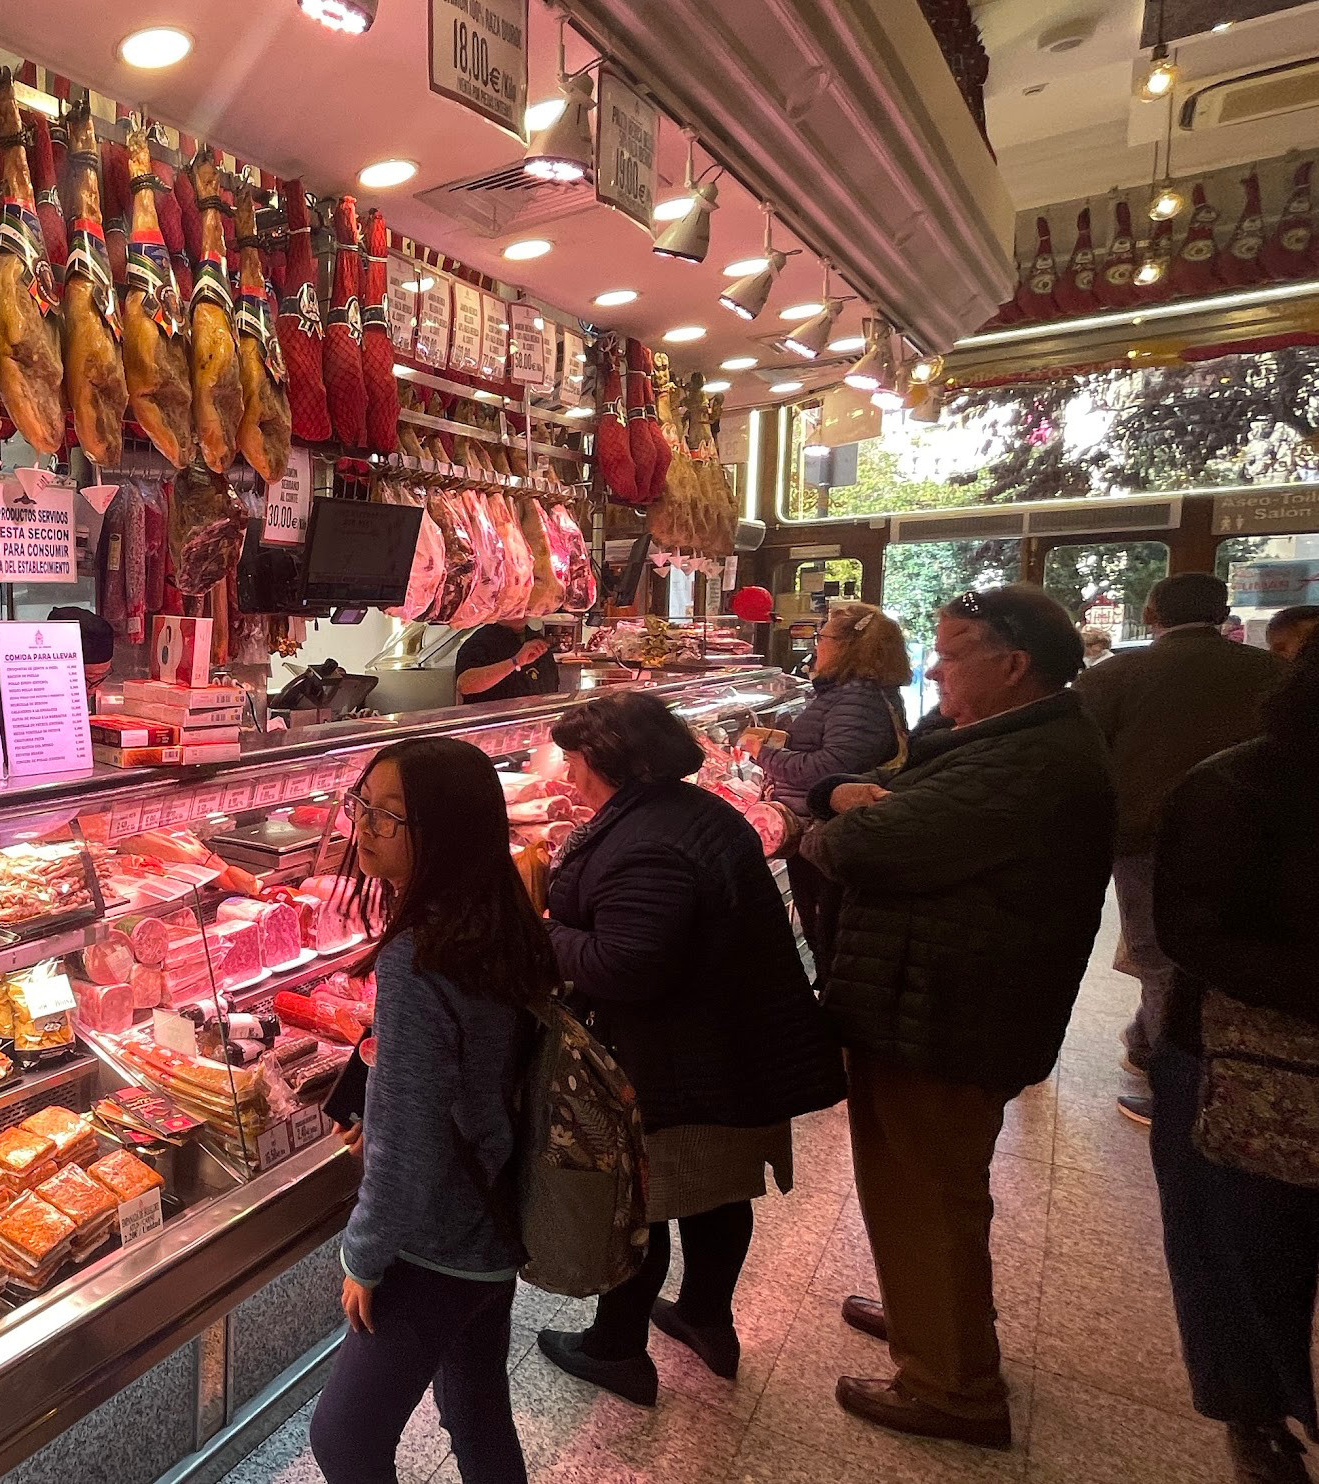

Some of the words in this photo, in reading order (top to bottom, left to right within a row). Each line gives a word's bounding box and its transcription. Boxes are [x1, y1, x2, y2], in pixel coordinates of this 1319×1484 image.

[37, 509, 69, 525] SERVIDOS
[267, 503, 298, 530] 30,00€
[0, 526, 25, 540] ESTA
[27, 527, 70, 541] SECCION
[3, 542, 25, 557] PARA
[27, 543, 70, 558] CONSUMIR
[4, 560, 17, 574] DEL
[17, 560, 70, 575] ESTABLECIMIENTO
[4, 653, 32, 662] COMIDA
[33, 652, 52, 661] PARA
[52, 651, 78, 660] LLEVAR
